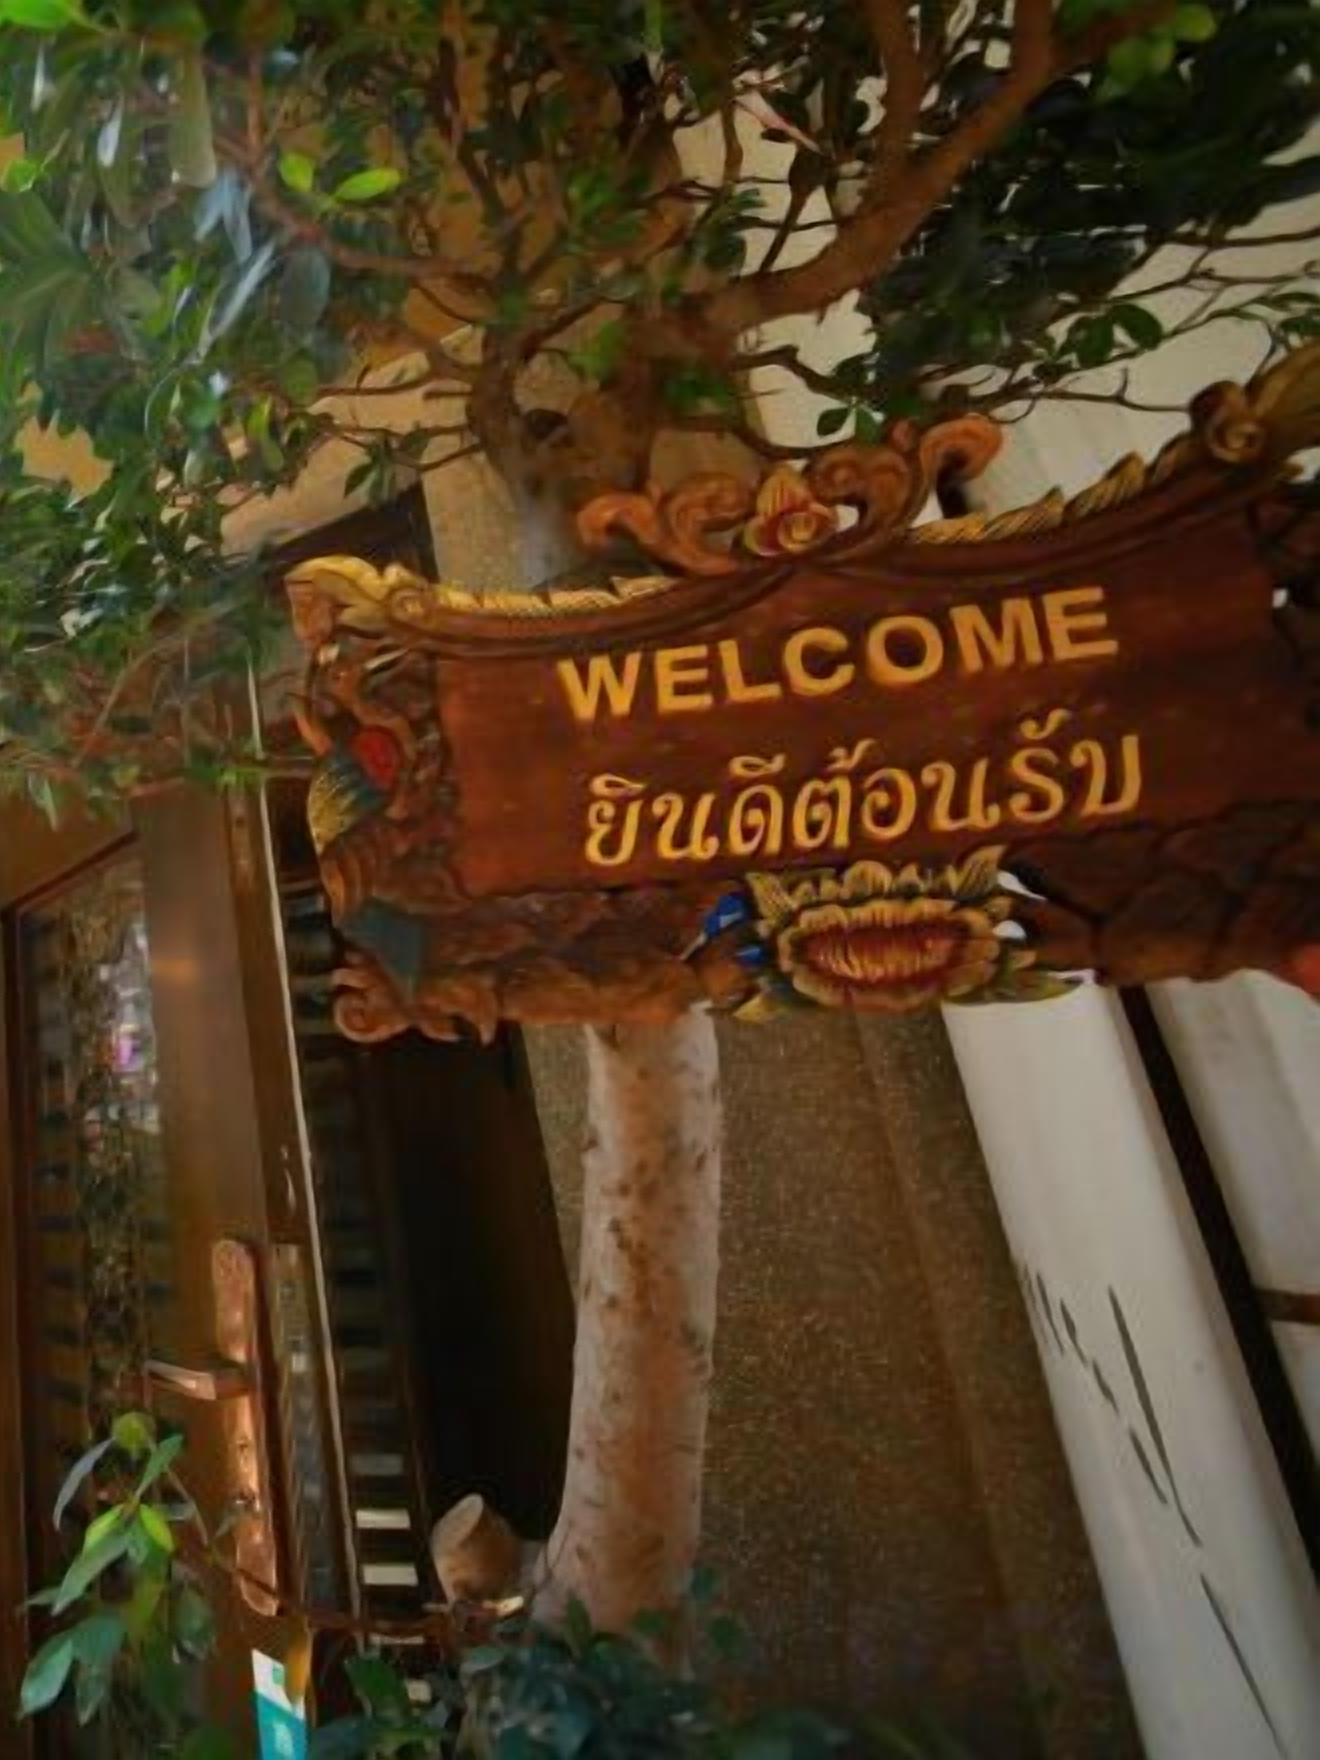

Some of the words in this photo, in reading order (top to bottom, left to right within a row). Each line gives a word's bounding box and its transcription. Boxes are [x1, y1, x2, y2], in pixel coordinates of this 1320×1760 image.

[556, 587, 1118, 721] WELCOME
[584, 708, 1142, 866] ยินดีต้อนรับ
